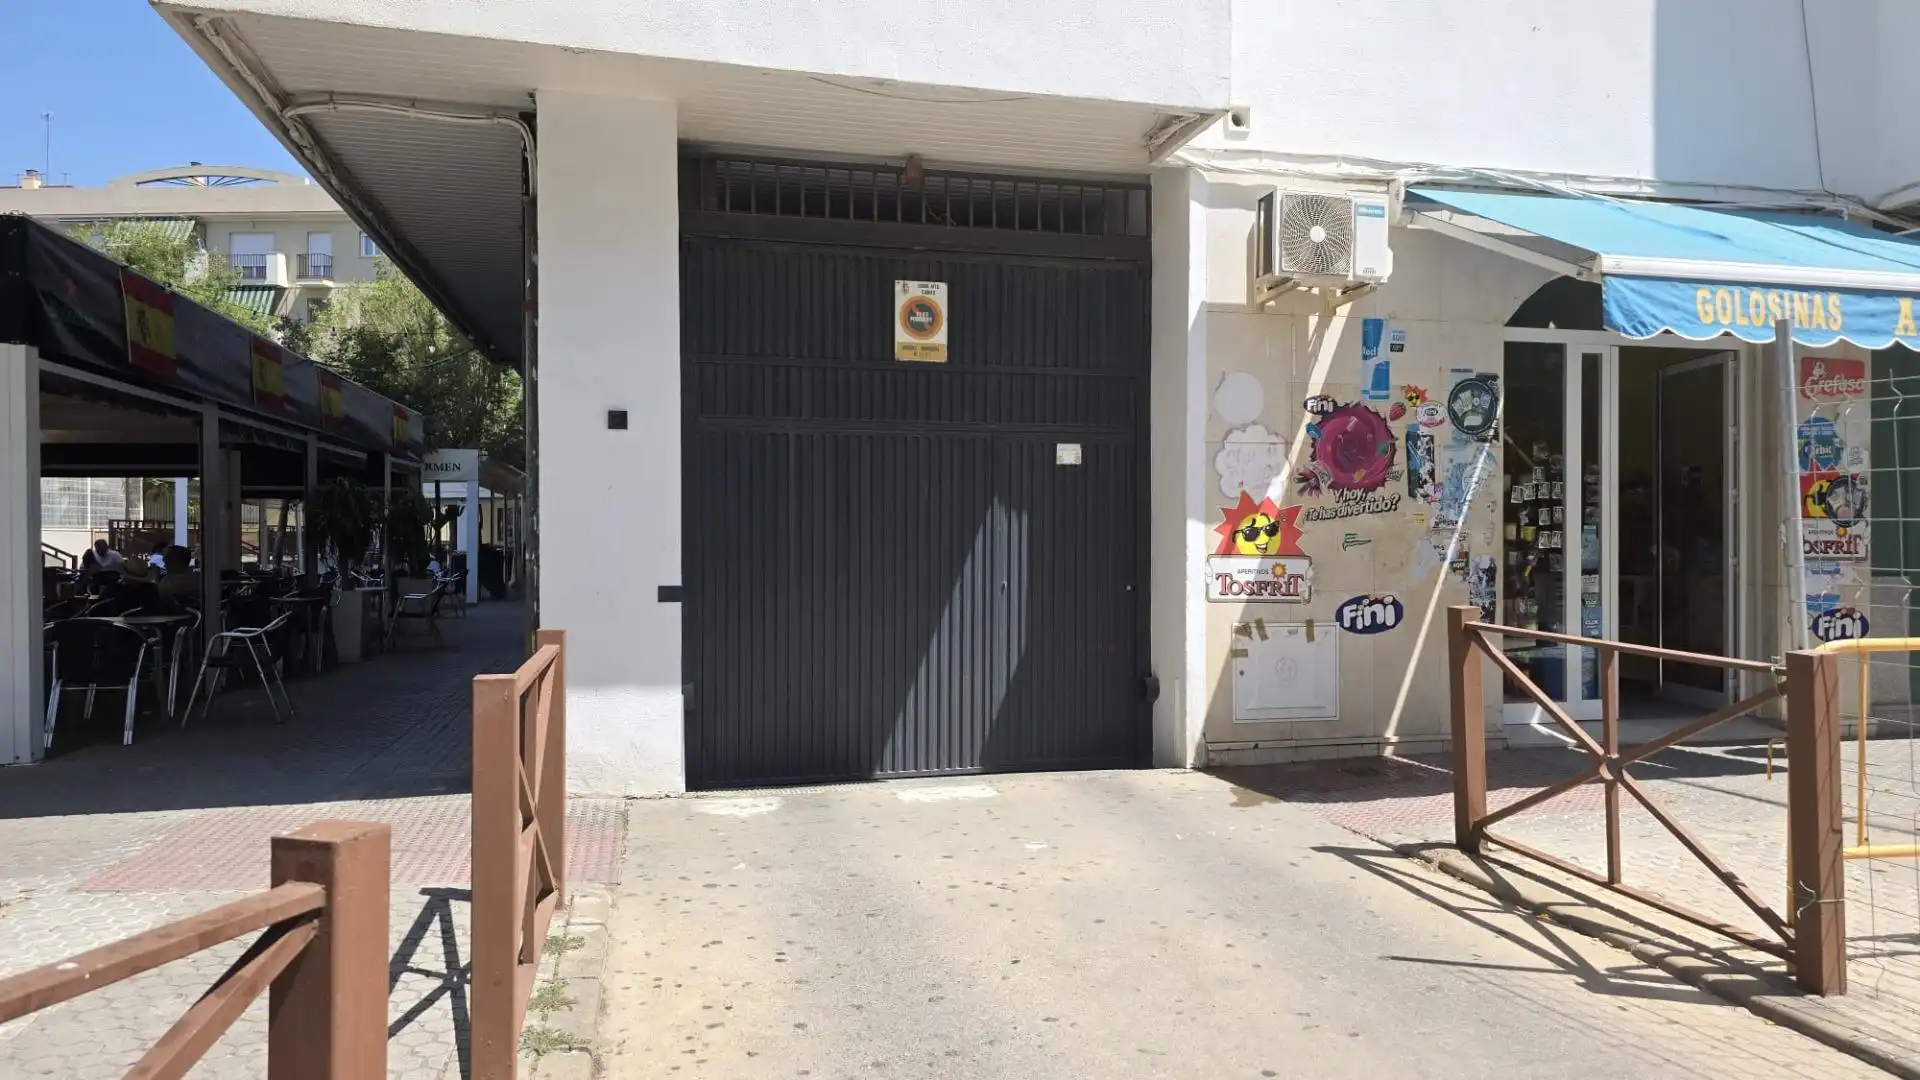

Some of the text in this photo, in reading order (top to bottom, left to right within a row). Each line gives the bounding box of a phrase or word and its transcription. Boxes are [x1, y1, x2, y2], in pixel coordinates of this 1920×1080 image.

[1696, 287, 1843, 331] GOLOSINAS
[424, 462, 461, 472] RMEN
[1336, 493, 1401, 519] divertido?
[1803, 533, 1863, 555] OSFRIT
[1342, 595, 1396, 630] Fini
[1818, 609, 1862, 639] Fini
